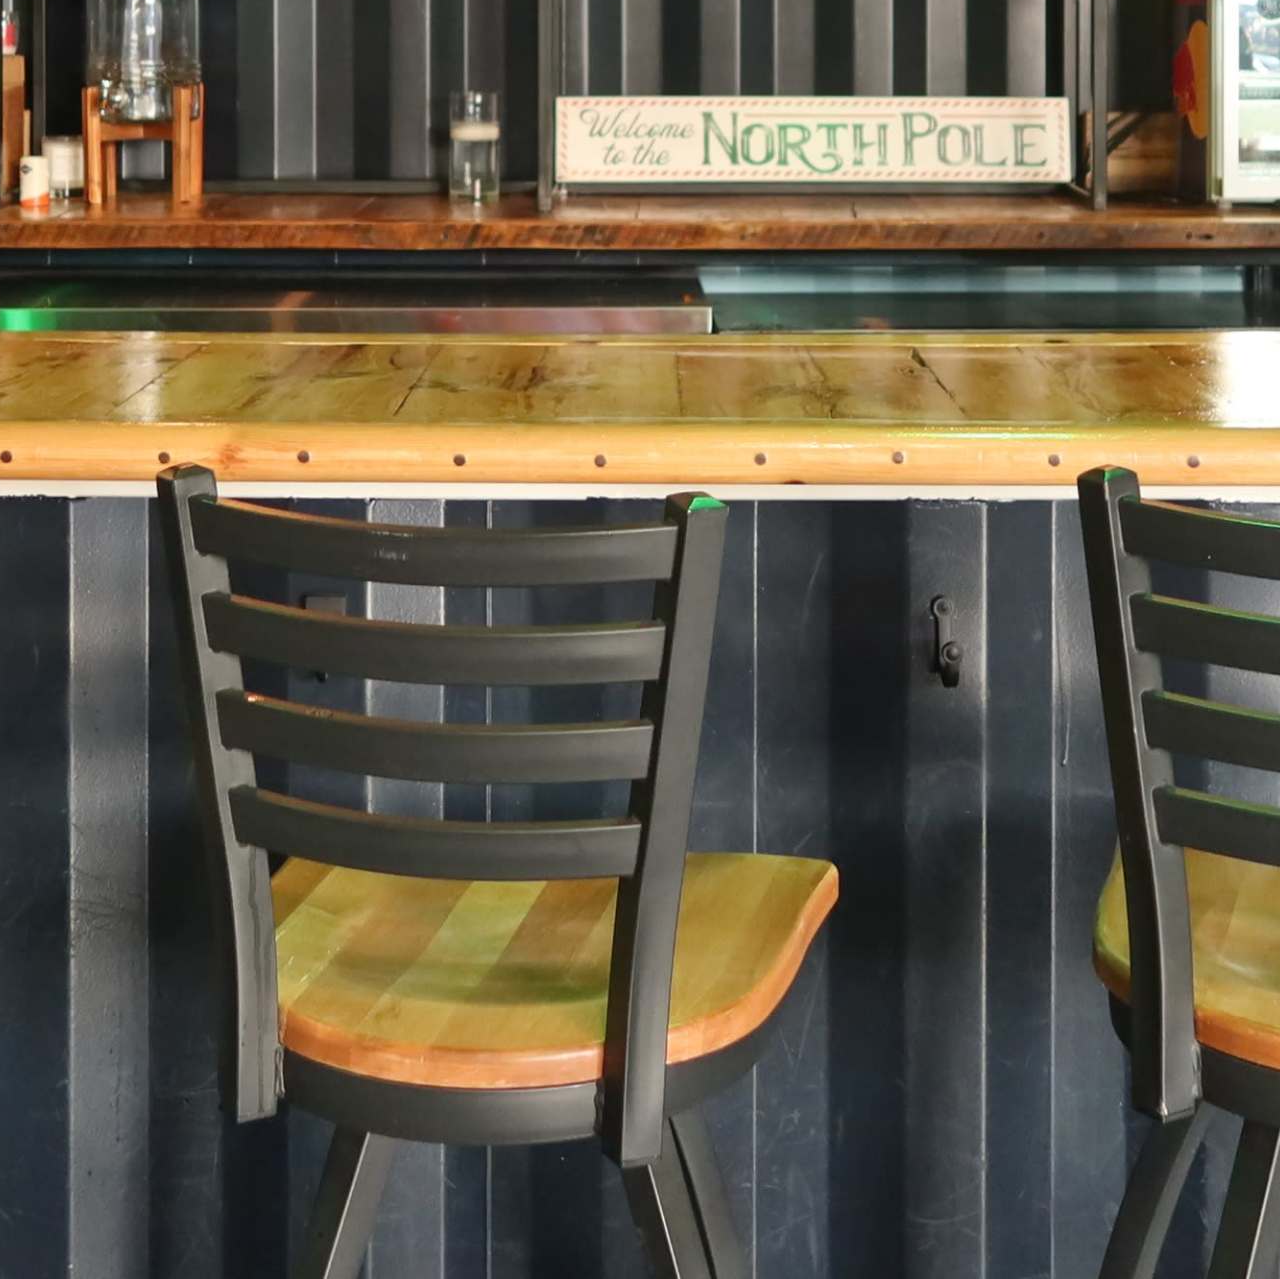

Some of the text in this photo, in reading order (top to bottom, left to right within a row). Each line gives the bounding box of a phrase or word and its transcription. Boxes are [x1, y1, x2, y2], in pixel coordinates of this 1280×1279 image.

[579, 108, 694, 140] Welcome
[603, 136, 671, 166] to the
[701, 111, 1049, 173] NORTH POLE
